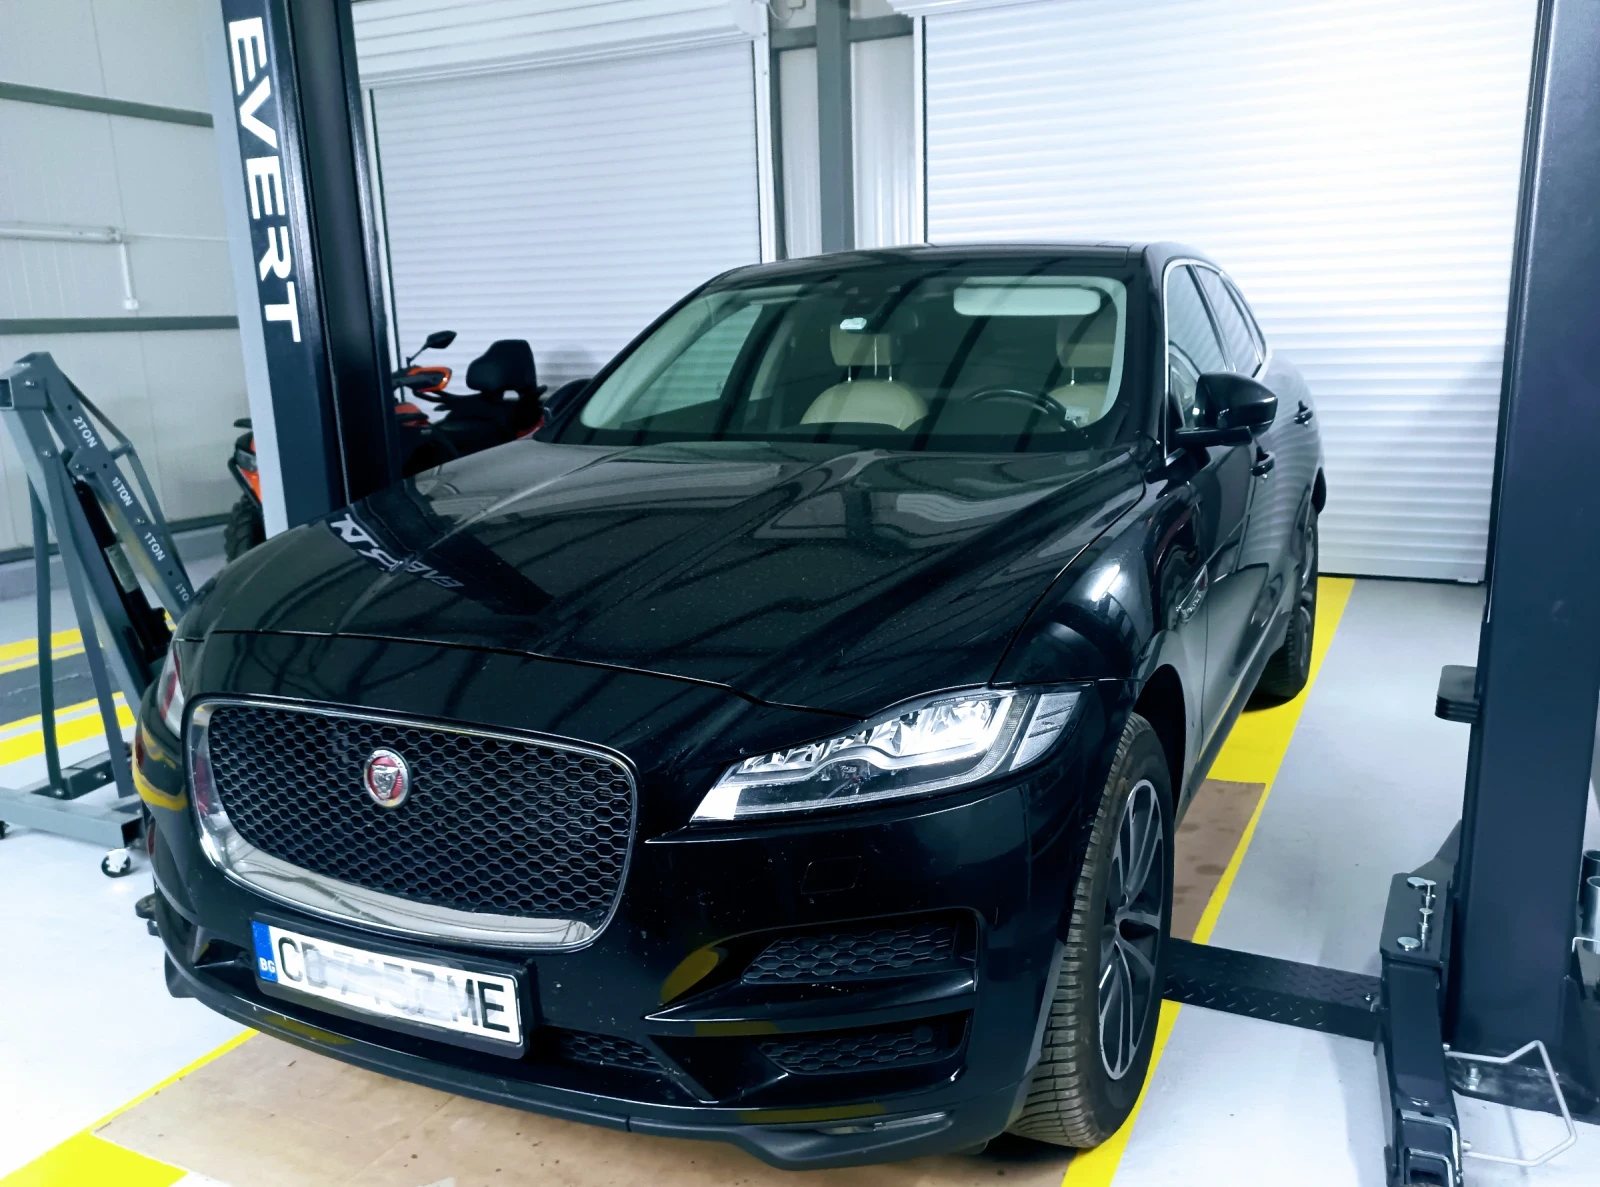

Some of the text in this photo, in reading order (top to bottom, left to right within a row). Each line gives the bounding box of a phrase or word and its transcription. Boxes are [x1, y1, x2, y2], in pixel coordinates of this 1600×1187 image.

[229, 17, 302, 342] EVERT
[73, 415, 98, 448] 2TON
[144, 532, 166, 561] 1TON
[259, 957, 276, 973] BG
